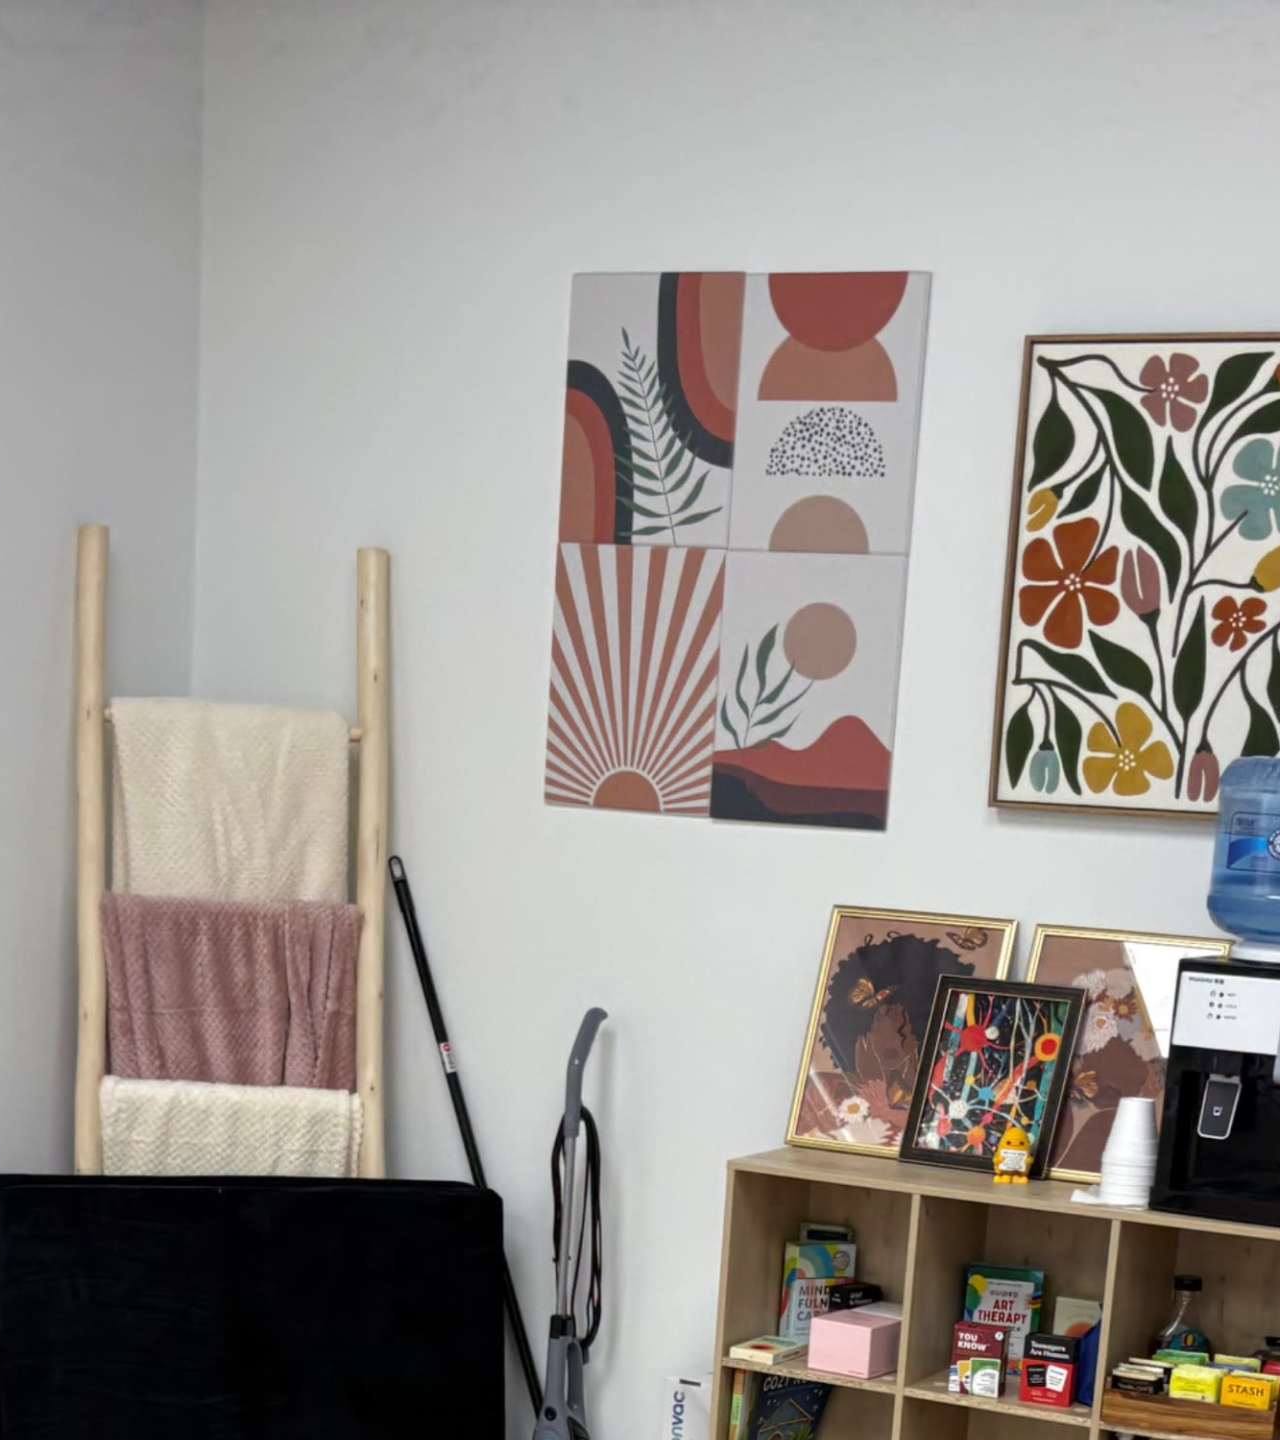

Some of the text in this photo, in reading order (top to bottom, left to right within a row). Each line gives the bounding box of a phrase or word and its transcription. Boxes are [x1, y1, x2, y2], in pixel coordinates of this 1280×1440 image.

[993, 1300, 1014, 1311] ART
[977, 1310, 1028, 1324] THERAPY
[957, 1341, 987, 1352] KNOW
[1227, 1383, 1265, 1397] STASH
